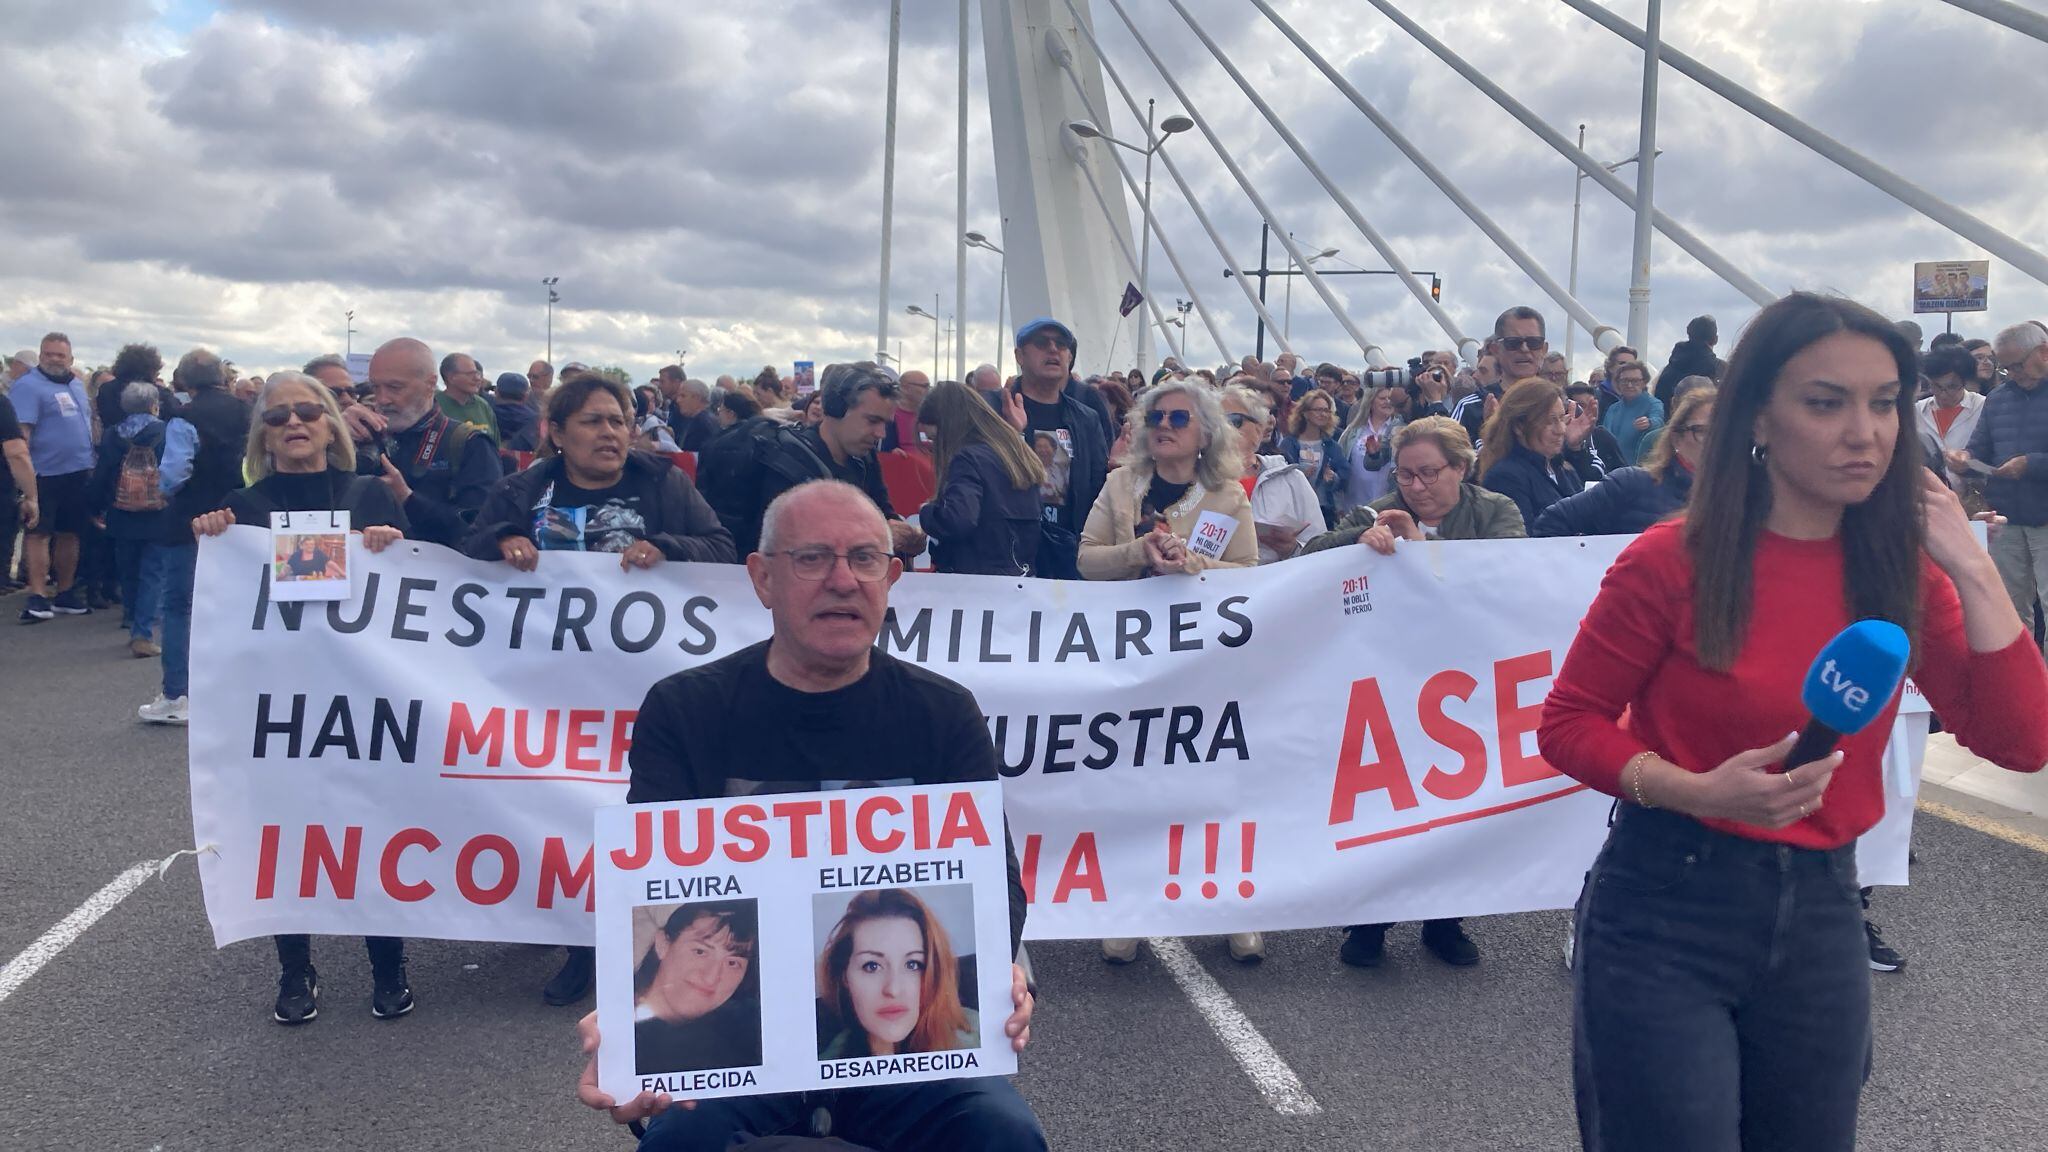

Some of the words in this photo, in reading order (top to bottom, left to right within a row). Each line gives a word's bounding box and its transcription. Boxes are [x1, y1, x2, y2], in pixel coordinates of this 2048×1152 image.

[1057, 430, 1070, 441] 20
[1041, 506, 1058, 523] SA
[1200, 521, 1228, 543] 20:11
[1342, 575, 1369, 595] 20:11
[1343, 596, 1351, 606] NI
[1351, 592, 1370, 605] OBLIT
[1344, 607, 1351, 616] NI
[252, 563, 717, 655] NUESTROS
[877, 596, 1253, 663] MILIARES
[1820, 658, 1870, 712] tve
[252, 693, 423, 763] HAN
[983, 701, 1250, 778] UESTRA
[1328, 649, 1564, 826] ASE
[610, 791, 992, 871] JUSTICIA
[255, 824, 596, 913] INCOM
[1021, 831, 1108, 905] IA
[819, 859, 965, 889] ELIZABETH
[646, 875, 743, 900] ELVIRA
[820, 1051, 979, 1080] DESAPARECIDA
[641, 1070, 757, 1094] FALLECIDA
